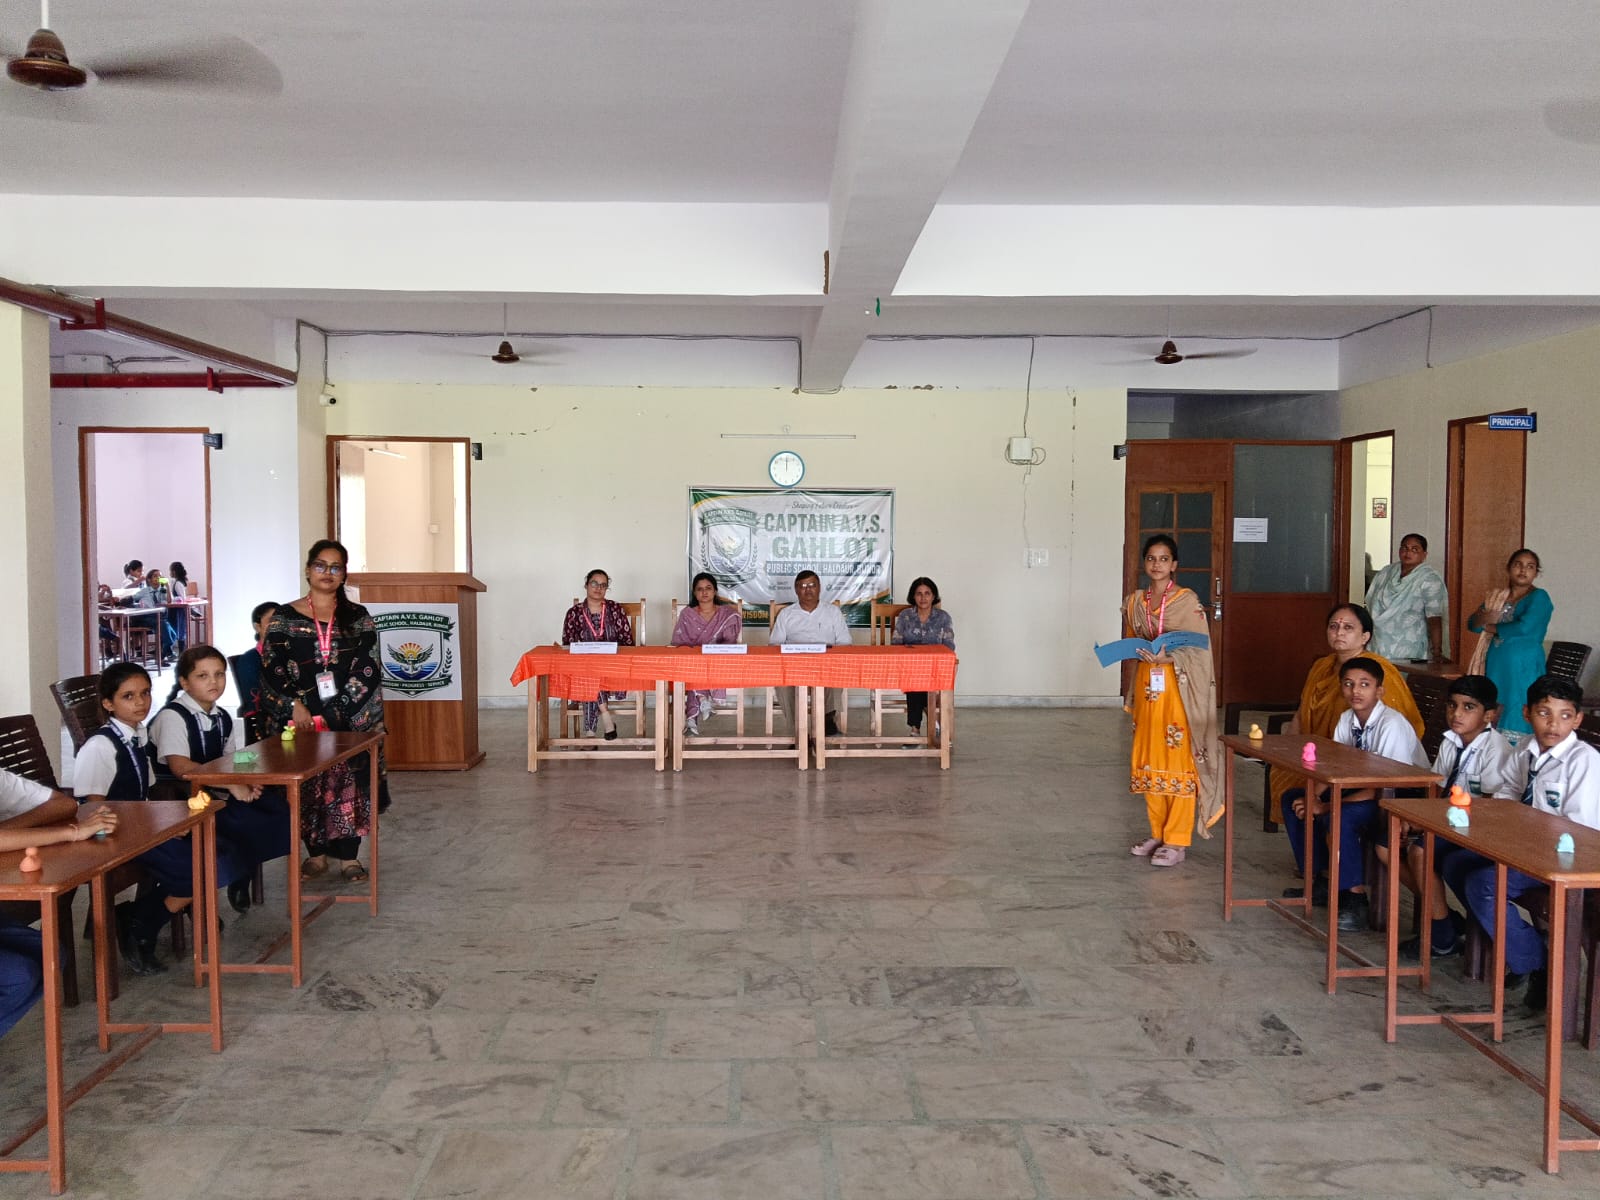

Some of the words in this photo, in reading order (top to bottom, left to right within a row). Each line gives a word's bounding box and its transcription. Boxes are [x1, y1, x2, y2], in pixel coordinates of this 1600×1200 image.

[1492, 418, 1530, 427] PRINCIPAL
[764, 513, 836, 533] CAPTAIN
[839, 513, 885, 534] A.V.S.
[772, 537, 879, 559] GAHLOT
[766, 562, 792, 574] PUBLIC
[373, 614, 400, 623] CAPTAIN
